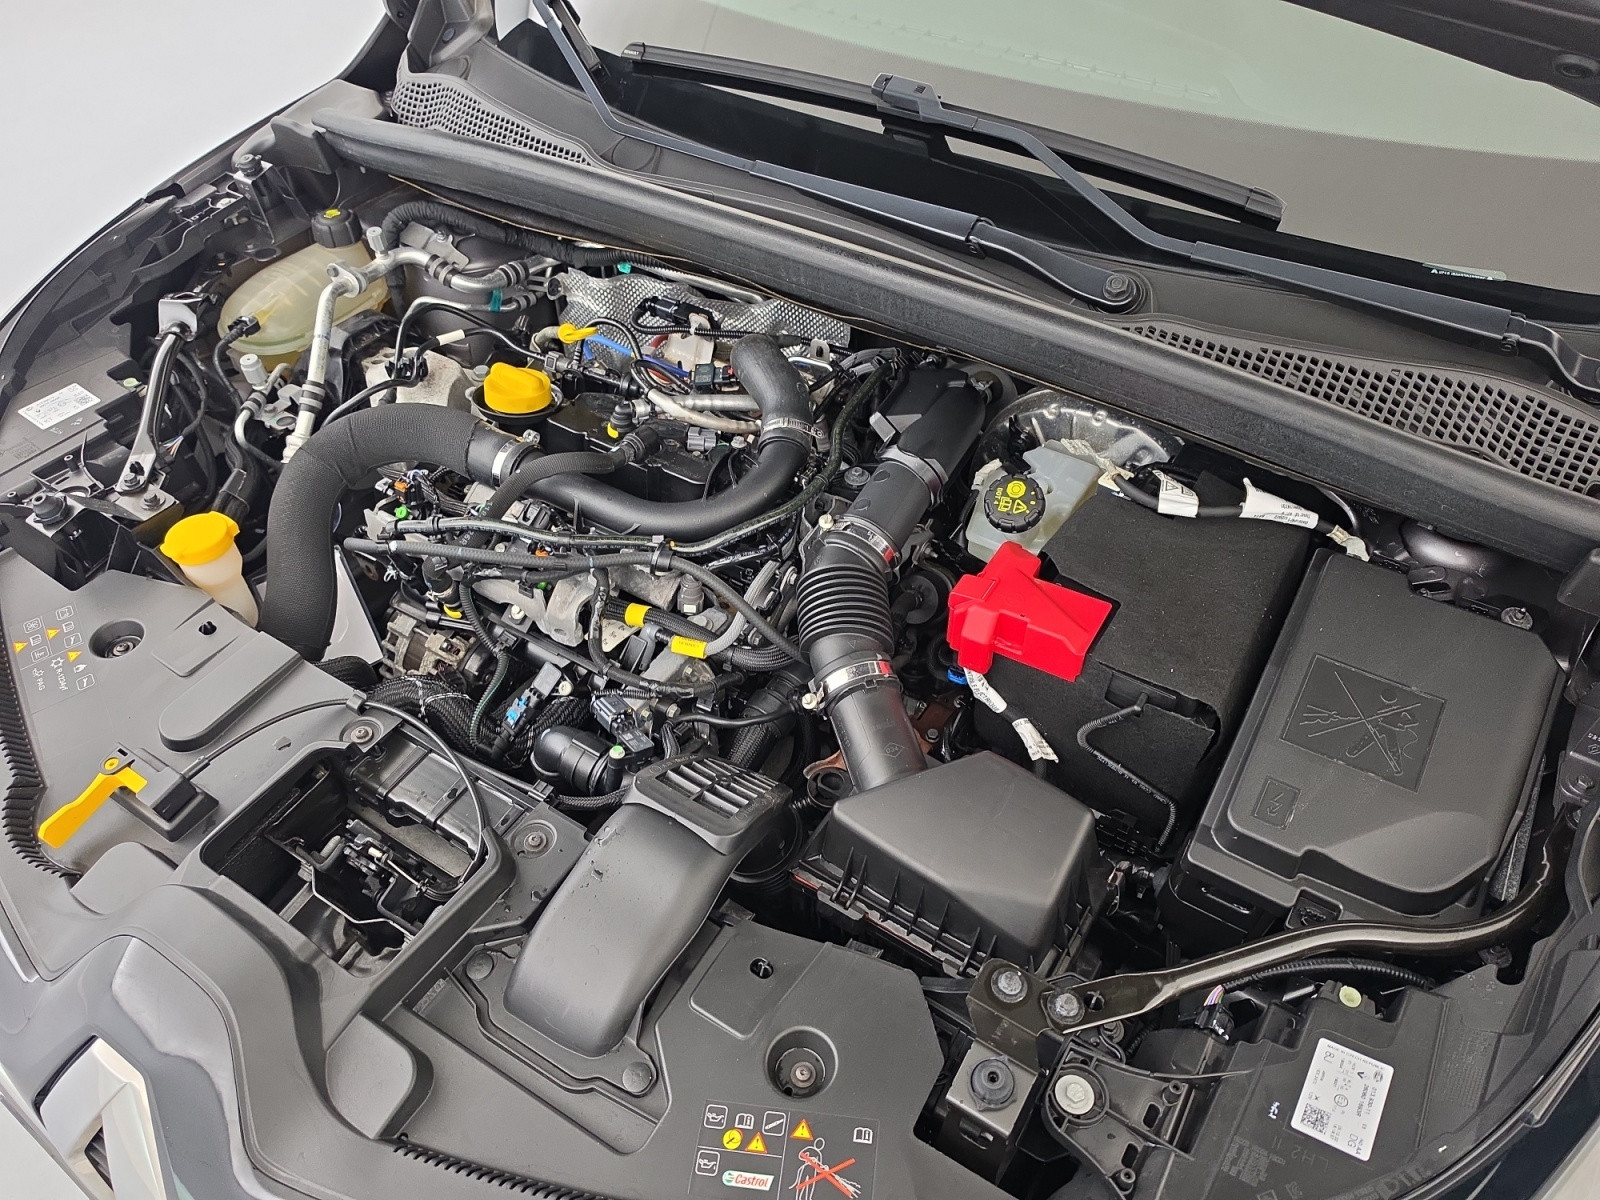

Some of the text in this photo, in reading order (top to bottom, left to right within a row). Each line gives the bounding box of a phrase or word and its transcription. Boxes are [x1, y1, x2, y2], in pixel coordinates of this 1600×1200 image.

[994, 487, 1003, 500] DOT
[36, 677, 46, 691] PAG
[1327, 1044, 1339, 1052] MADE
[1347, 1133, 1359, 1149] DG
[734, 1173, 769, 1188] Castrol
